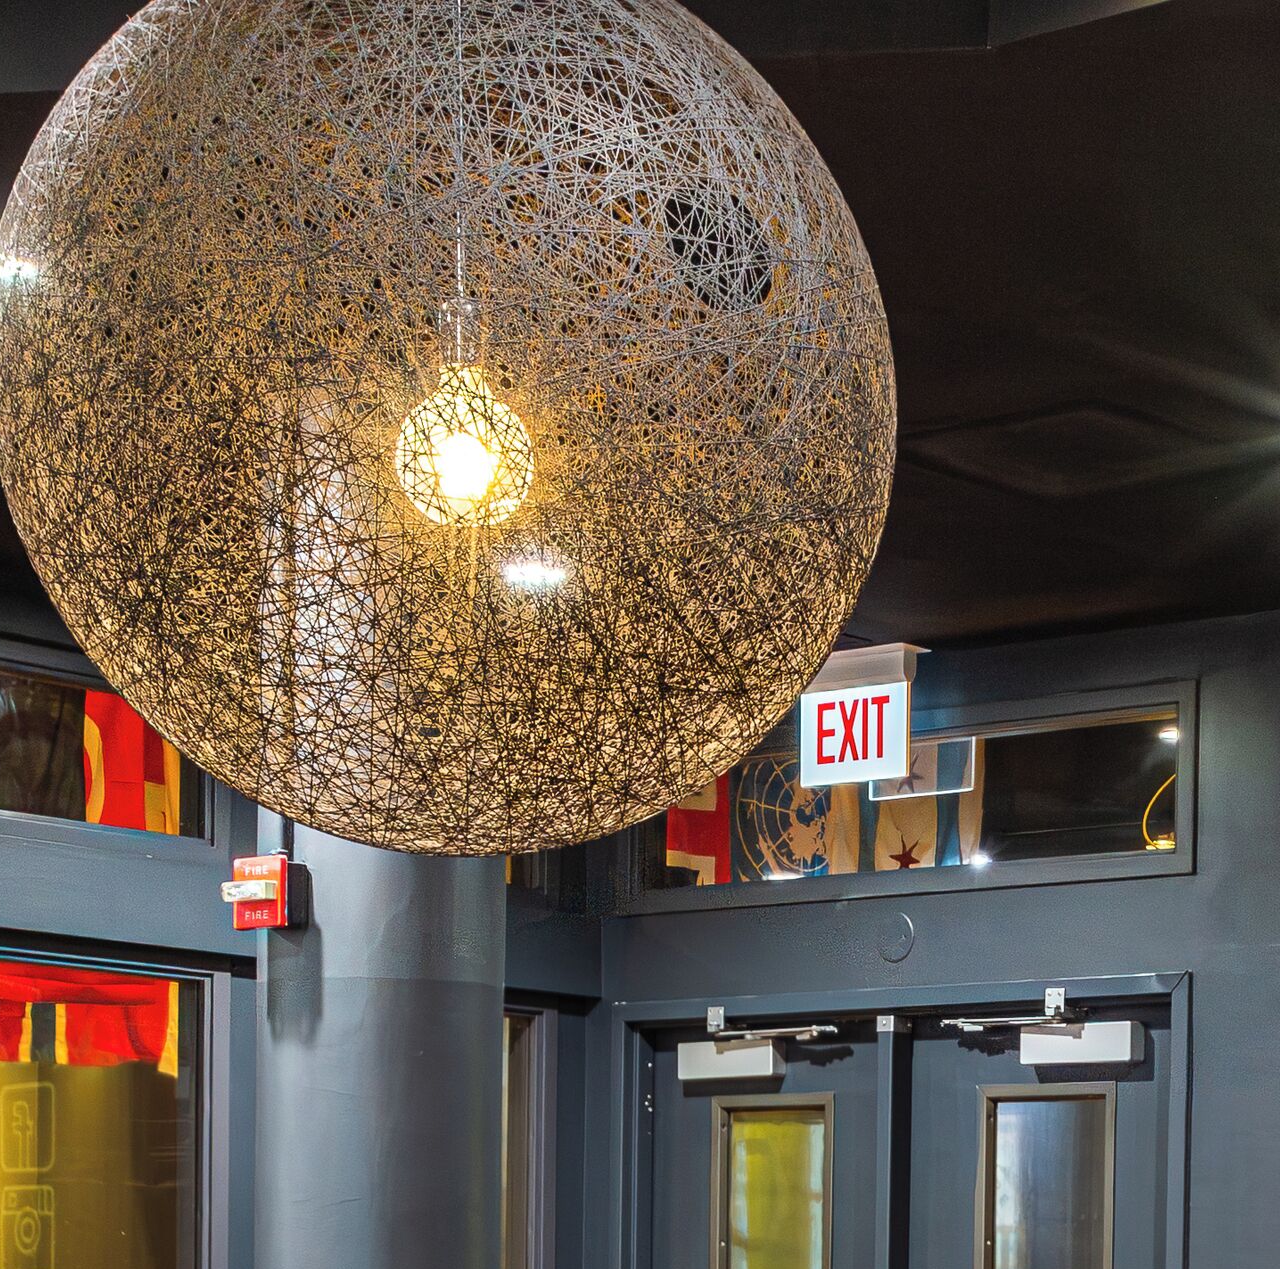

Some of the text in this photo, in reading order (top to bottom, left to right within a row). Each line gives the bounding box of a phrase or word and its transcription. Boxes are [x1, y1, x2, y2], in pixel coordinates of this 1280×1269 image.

[816, 695, 890, 765] EXIT
[244, 864, 270, 877] FIRE
[244, 909, 270, 920] FIRE
